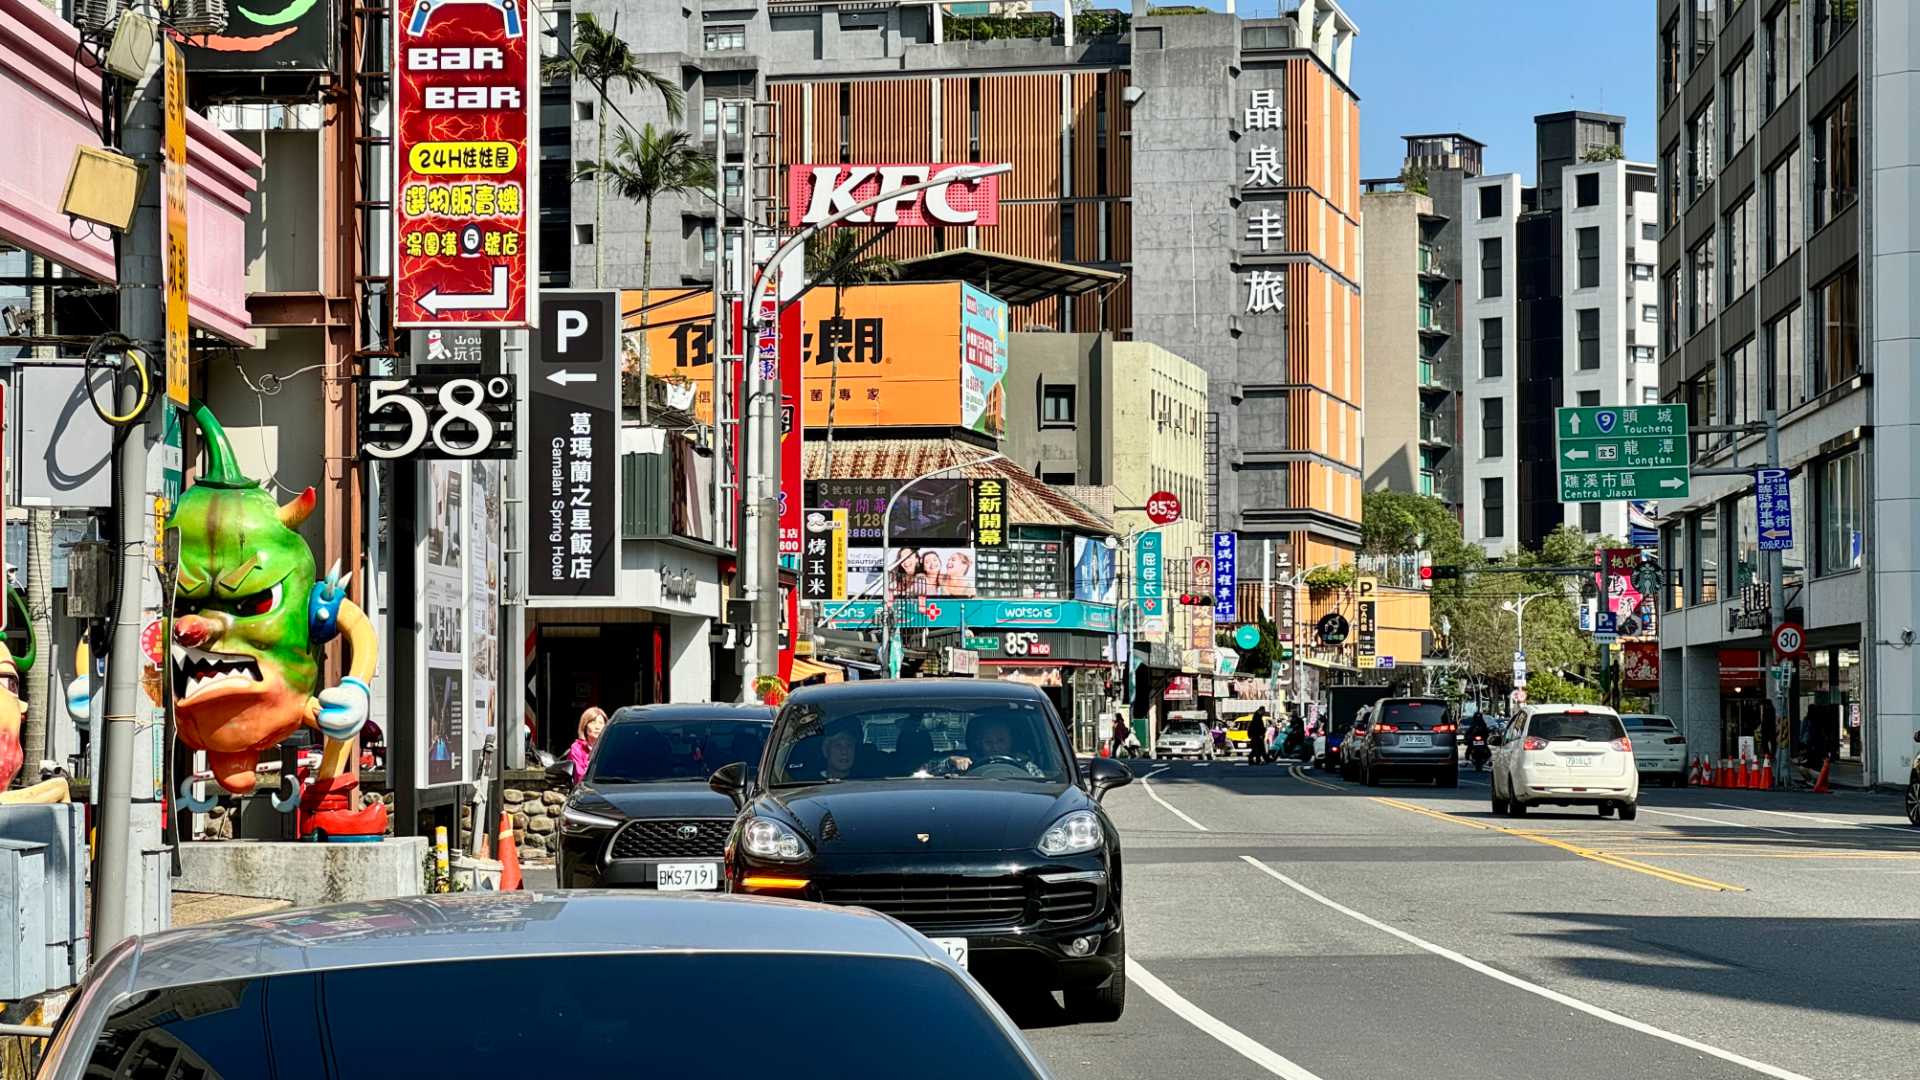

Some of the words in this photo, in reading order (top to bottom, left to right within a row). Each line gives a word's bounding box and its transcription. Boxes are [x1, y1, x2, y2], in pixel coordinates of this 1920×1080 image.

[418, 147, 510, 169] 24H娃娃屋
[405, 184, 521, 217] 選物販賣機
[802, 165, 983, 224] KFC
[1244, 89, 1285, 313] 晶泉丰旅
[556, 309, 589, 354] P
[1599, 414, 1612, 427] 9
[1622, 407, 1674, 423] 頭城
[1623, 425, 1674, 435] Toucheng
[1623, 438, 1675, 456] 龍潭
[551, 437, 565, 497] Gamalan
[1628, 456, 1673, 467] Longtan
[1564, 471, 1637, 489] 礁溪市區
[1564, 489, 1601, 499] Central
[1606, 487, 1637, 498] Jiaoxi
[569, 412, 593, 580] 葛瑪蘭之星飯店
[549, 499, 565, 542] Spring
[977, 480, 1003, 546] 全新開幕
[551, 545, 565, 581] Hotel
[807, 538, 828, 596] 烤玉米
[1360, 581, 1373, 597] P
[1780, 632, 1799, 648] 30
